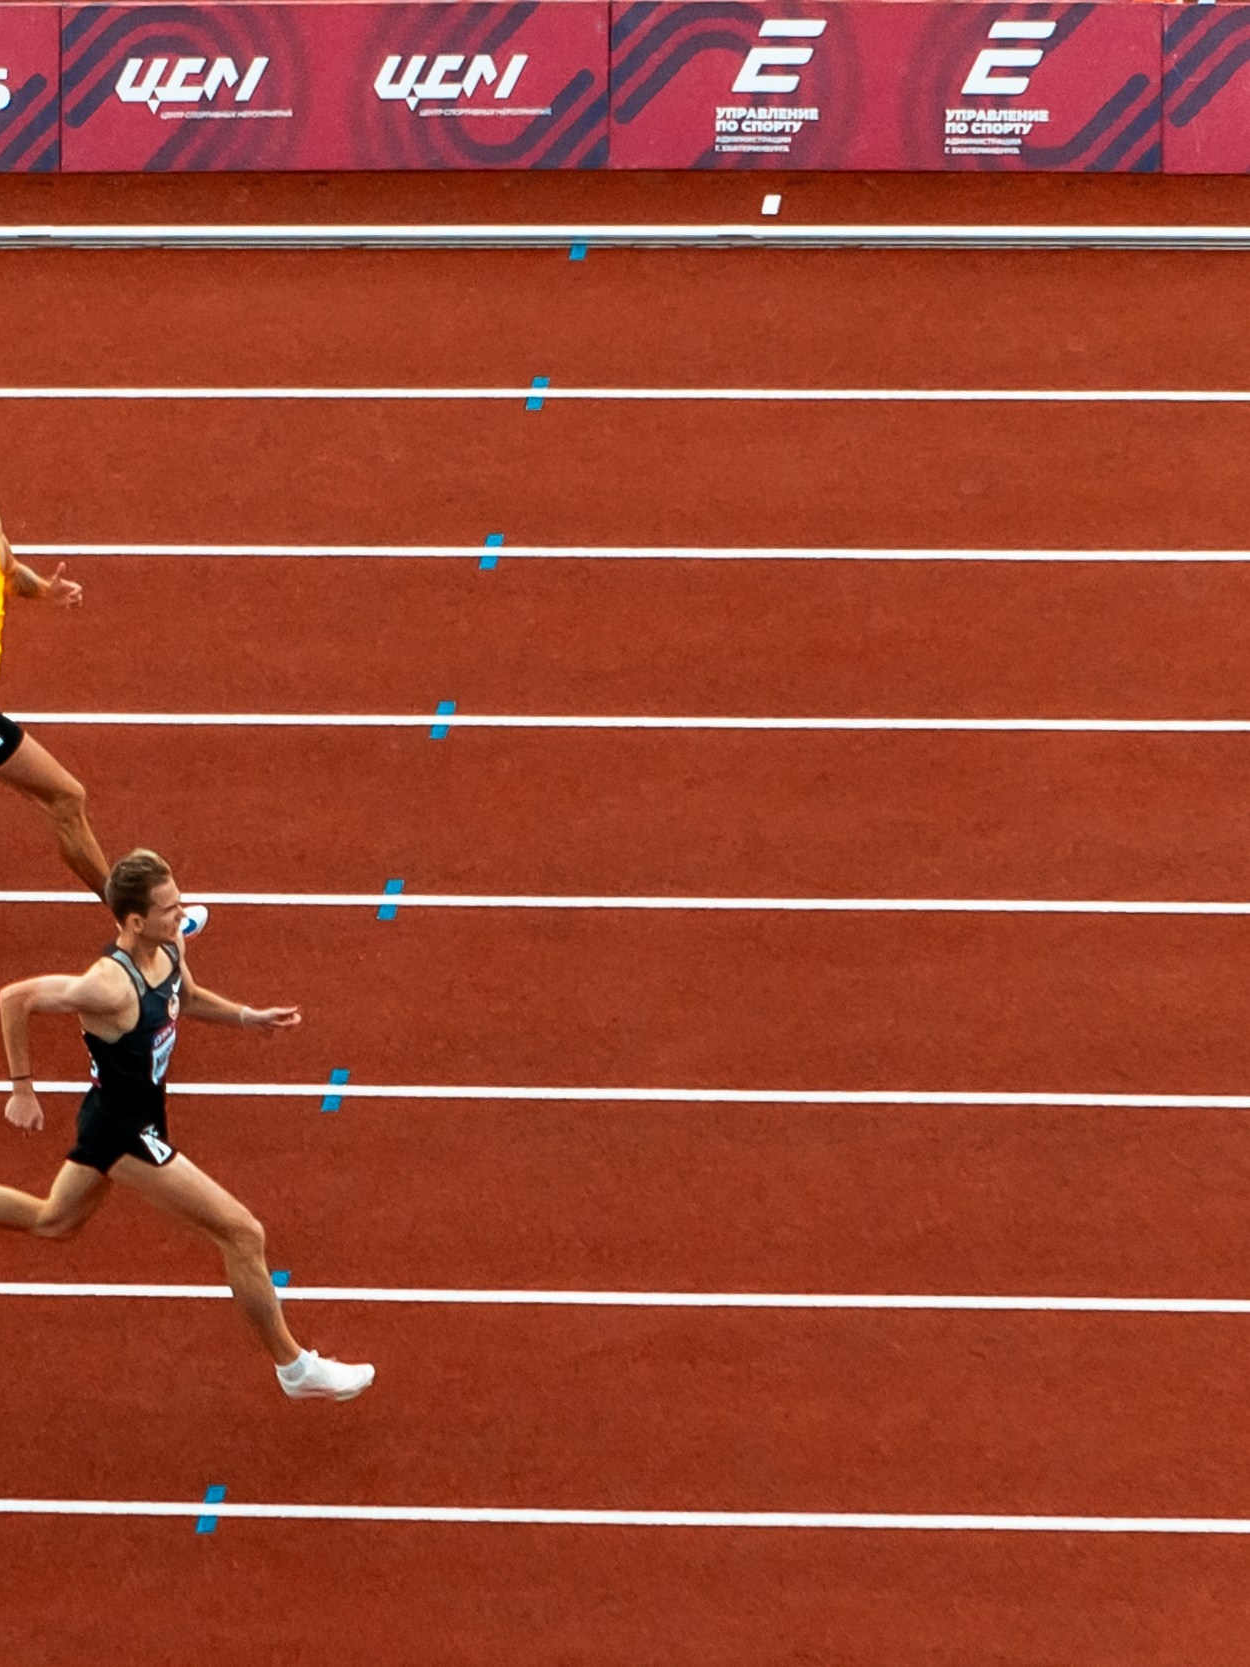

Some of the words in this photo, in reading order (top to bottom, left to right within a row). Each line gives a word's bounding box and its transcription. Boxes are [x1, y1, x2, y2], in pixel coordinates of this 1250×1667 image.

[715, 107, 820, 120] УПРАВЛЕНИЕ
[945, 109, 1050, 122] УПРАВЛЕНИЕ
[715, 120, 739, 133] ПО
[741, 121, 803, 134] СПОРТУ
[945, 122, 969, 134] ПО
[971, 123, 1033, 135] СПОРТУ
